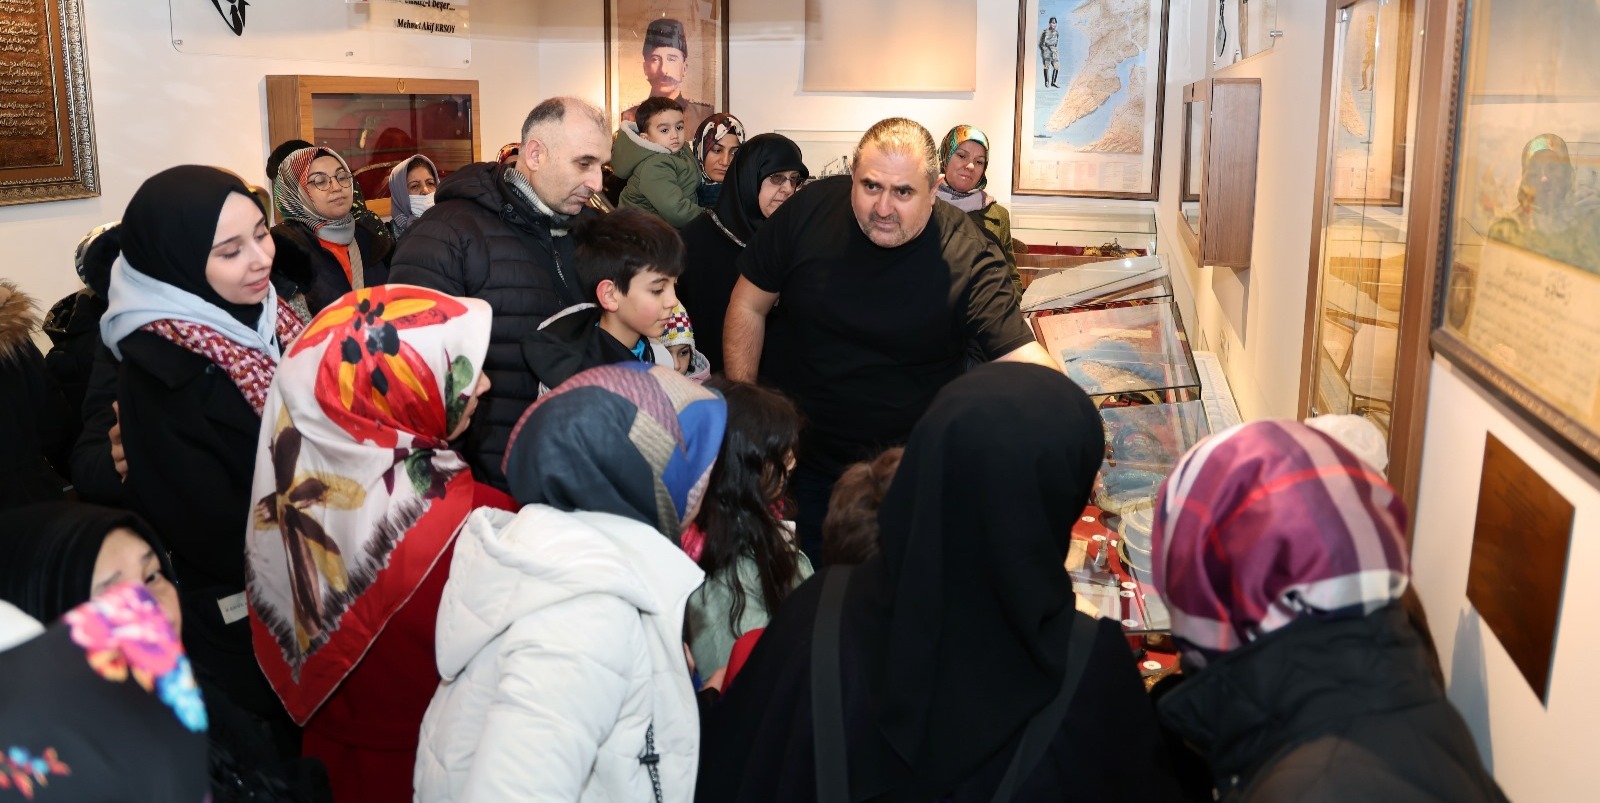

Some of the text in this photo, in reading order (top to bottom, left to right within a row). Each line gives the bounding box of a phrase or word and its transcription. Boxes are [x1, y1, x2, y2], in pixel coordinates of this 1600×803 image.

[397, 18, 456, 33] Mehmet Akif ERSOY
